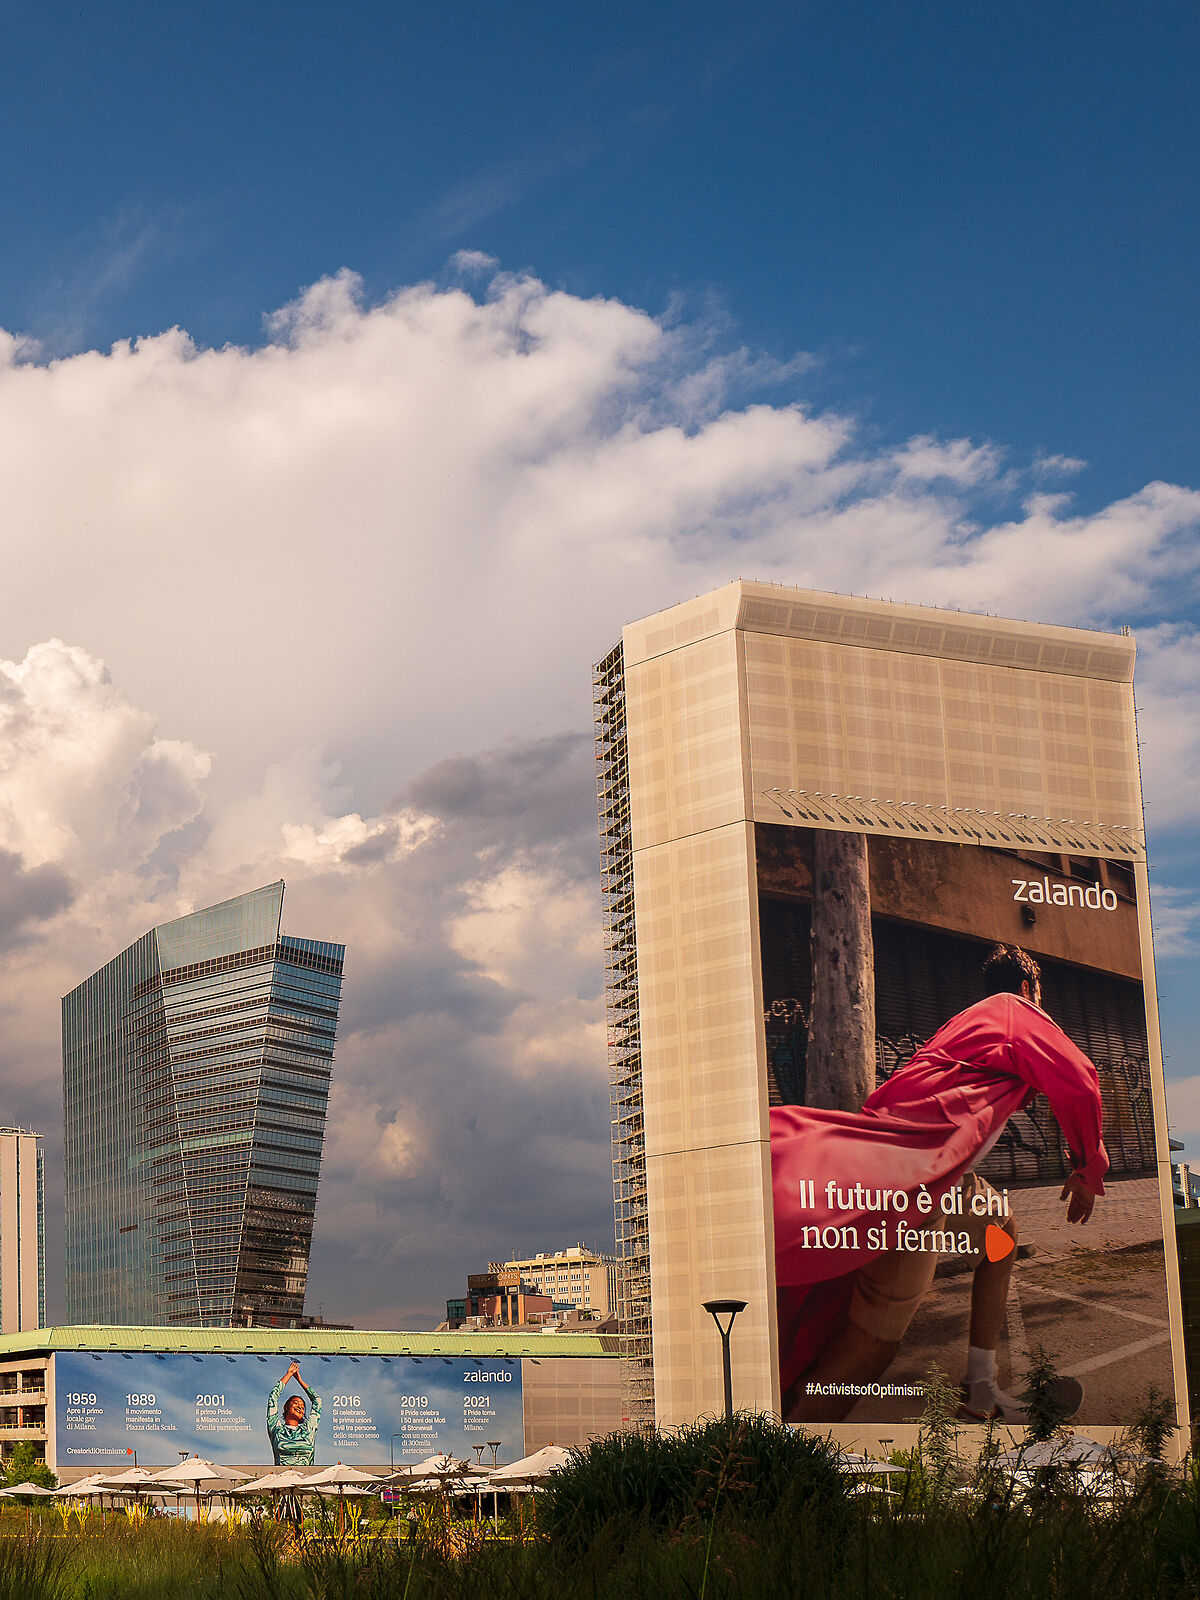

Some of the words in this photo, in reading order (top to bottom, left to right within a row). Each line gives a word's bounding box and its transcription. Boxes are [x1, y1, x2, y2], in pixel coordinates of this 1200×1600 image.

[1011, 876, 1118, 911] zalando
[799, 1180, 815, 1209] Il
[825, 1181, 909, 1213] futuro
[916, 1184, 933, 1214] è
[940, 1186, 963, 1215] di
[971, 1188, 1009, 1217] chi
[800, 1225, 861, 1249] non
[867, 1220, 888, 1250] si
[895, 1220, 980, 1255] ferma.
[464, 1369, 512, 1382] zalando
[66, 1393, 96, 1405] 1959
[126, 1394, 156, 1406] 1989
[196, 1394, 225, 1406] 2001
[333, 1395, 361, 1407] 2016
[401, 1396, 428, 1407] 2019
[464, 1396, 490, 1407] 2021
[220, 1416, 246, 1424] raccoglie
[217, 1424, 253, 1432] partecipanti.
